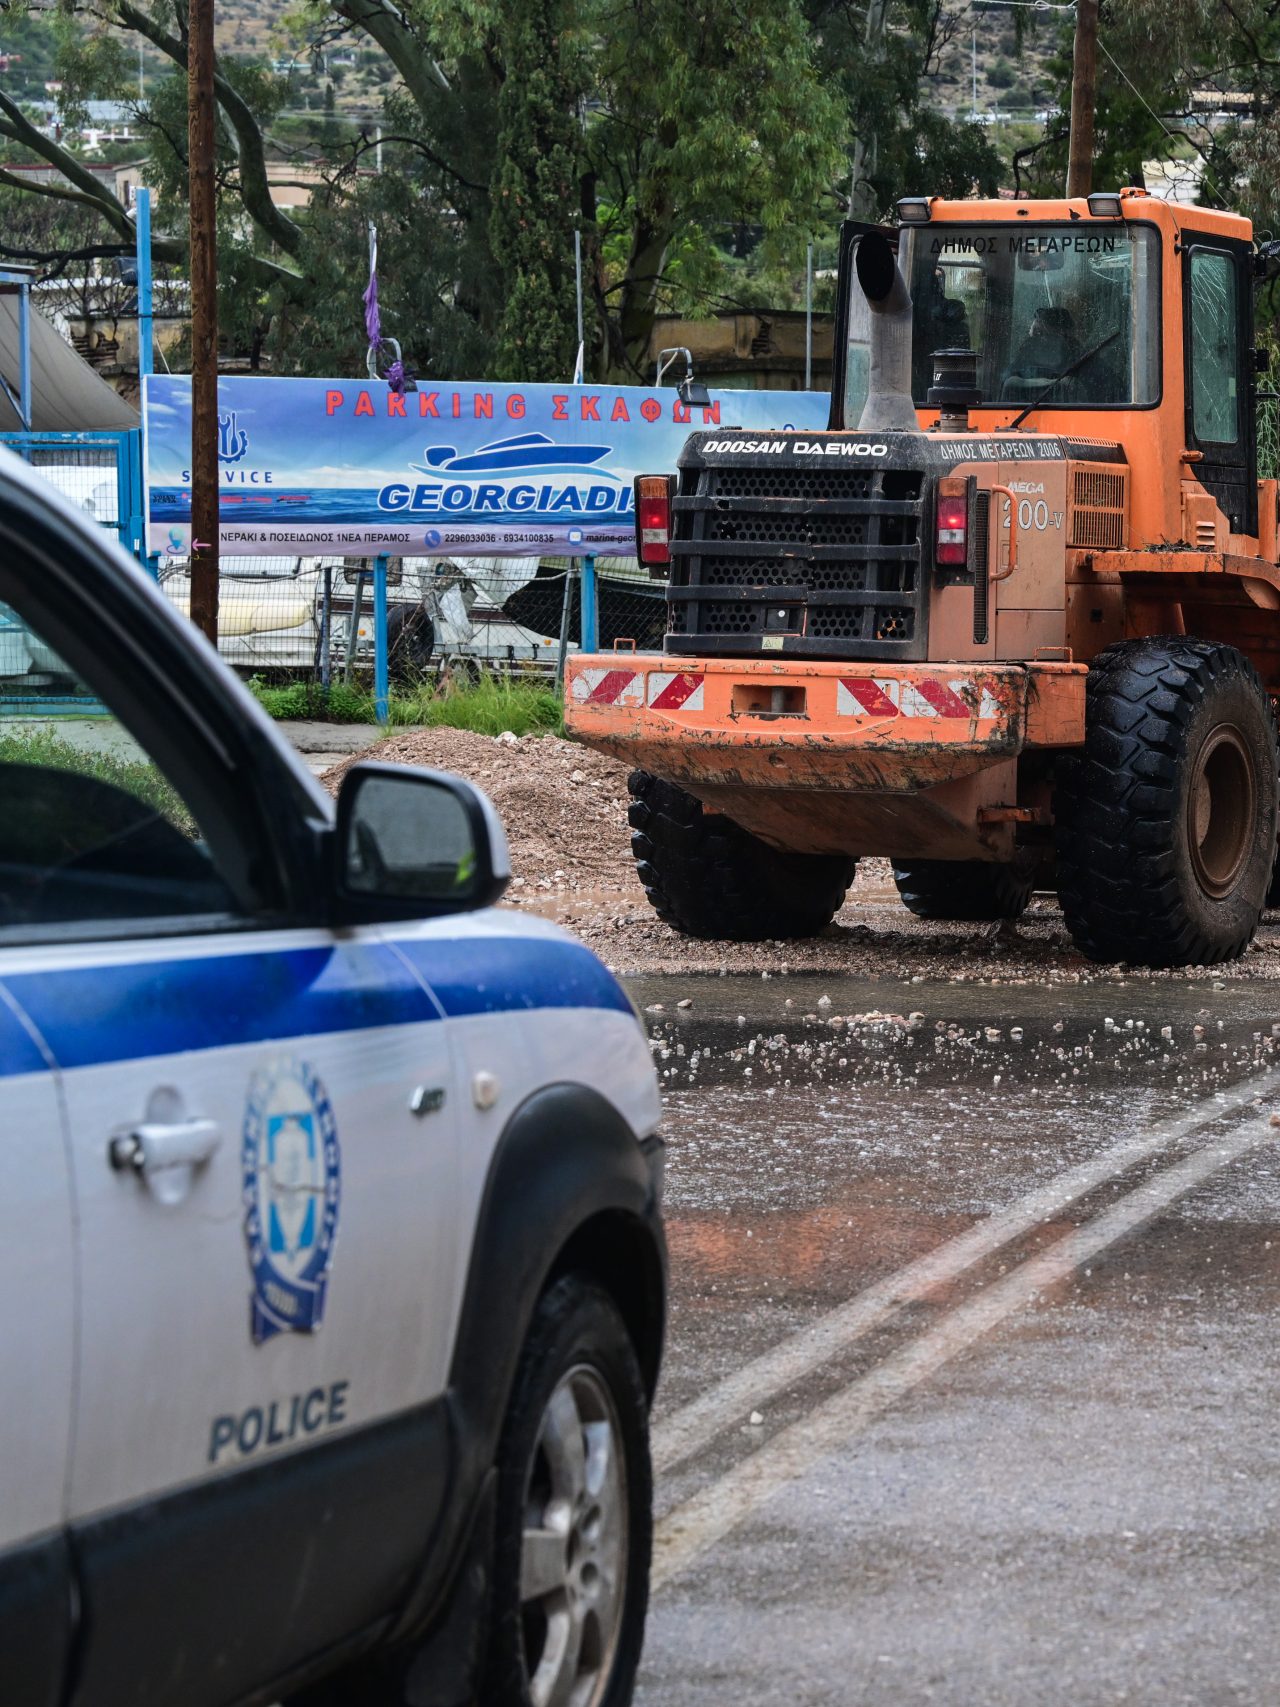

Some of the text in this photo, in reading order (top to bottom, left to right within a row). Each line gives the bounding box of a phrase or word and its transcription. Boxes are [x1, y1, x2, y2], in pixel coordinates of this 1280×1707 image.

[930, 236, 1116, 254] ΔΗΜΟΣ ΜΕΓΑΡΕΩΝ
[325, 389, 721, 425] PARKING ΣΚΑΦΩΝ
[701, 440, 888, 457] DOOSAN DAEWOO
[940, 442, 1061, 460] ΔΗΜΟΣ ΜΕΓΑΡΕΩΝ 2006
[181, 470, 273, 483] SVICE
[1007, 481, 1045, 494] MEGA
[259, 532, 267, 542] &
[269, 532, 334, 542] ΠΟΣΕΙΔΩΝΟΣ
[364, 532, 411, 543] ΠΕΡΑΜΟΣ
[503, 533, 554, 543] 6934100835
[207, 1379, 349, 1463] POLICE
